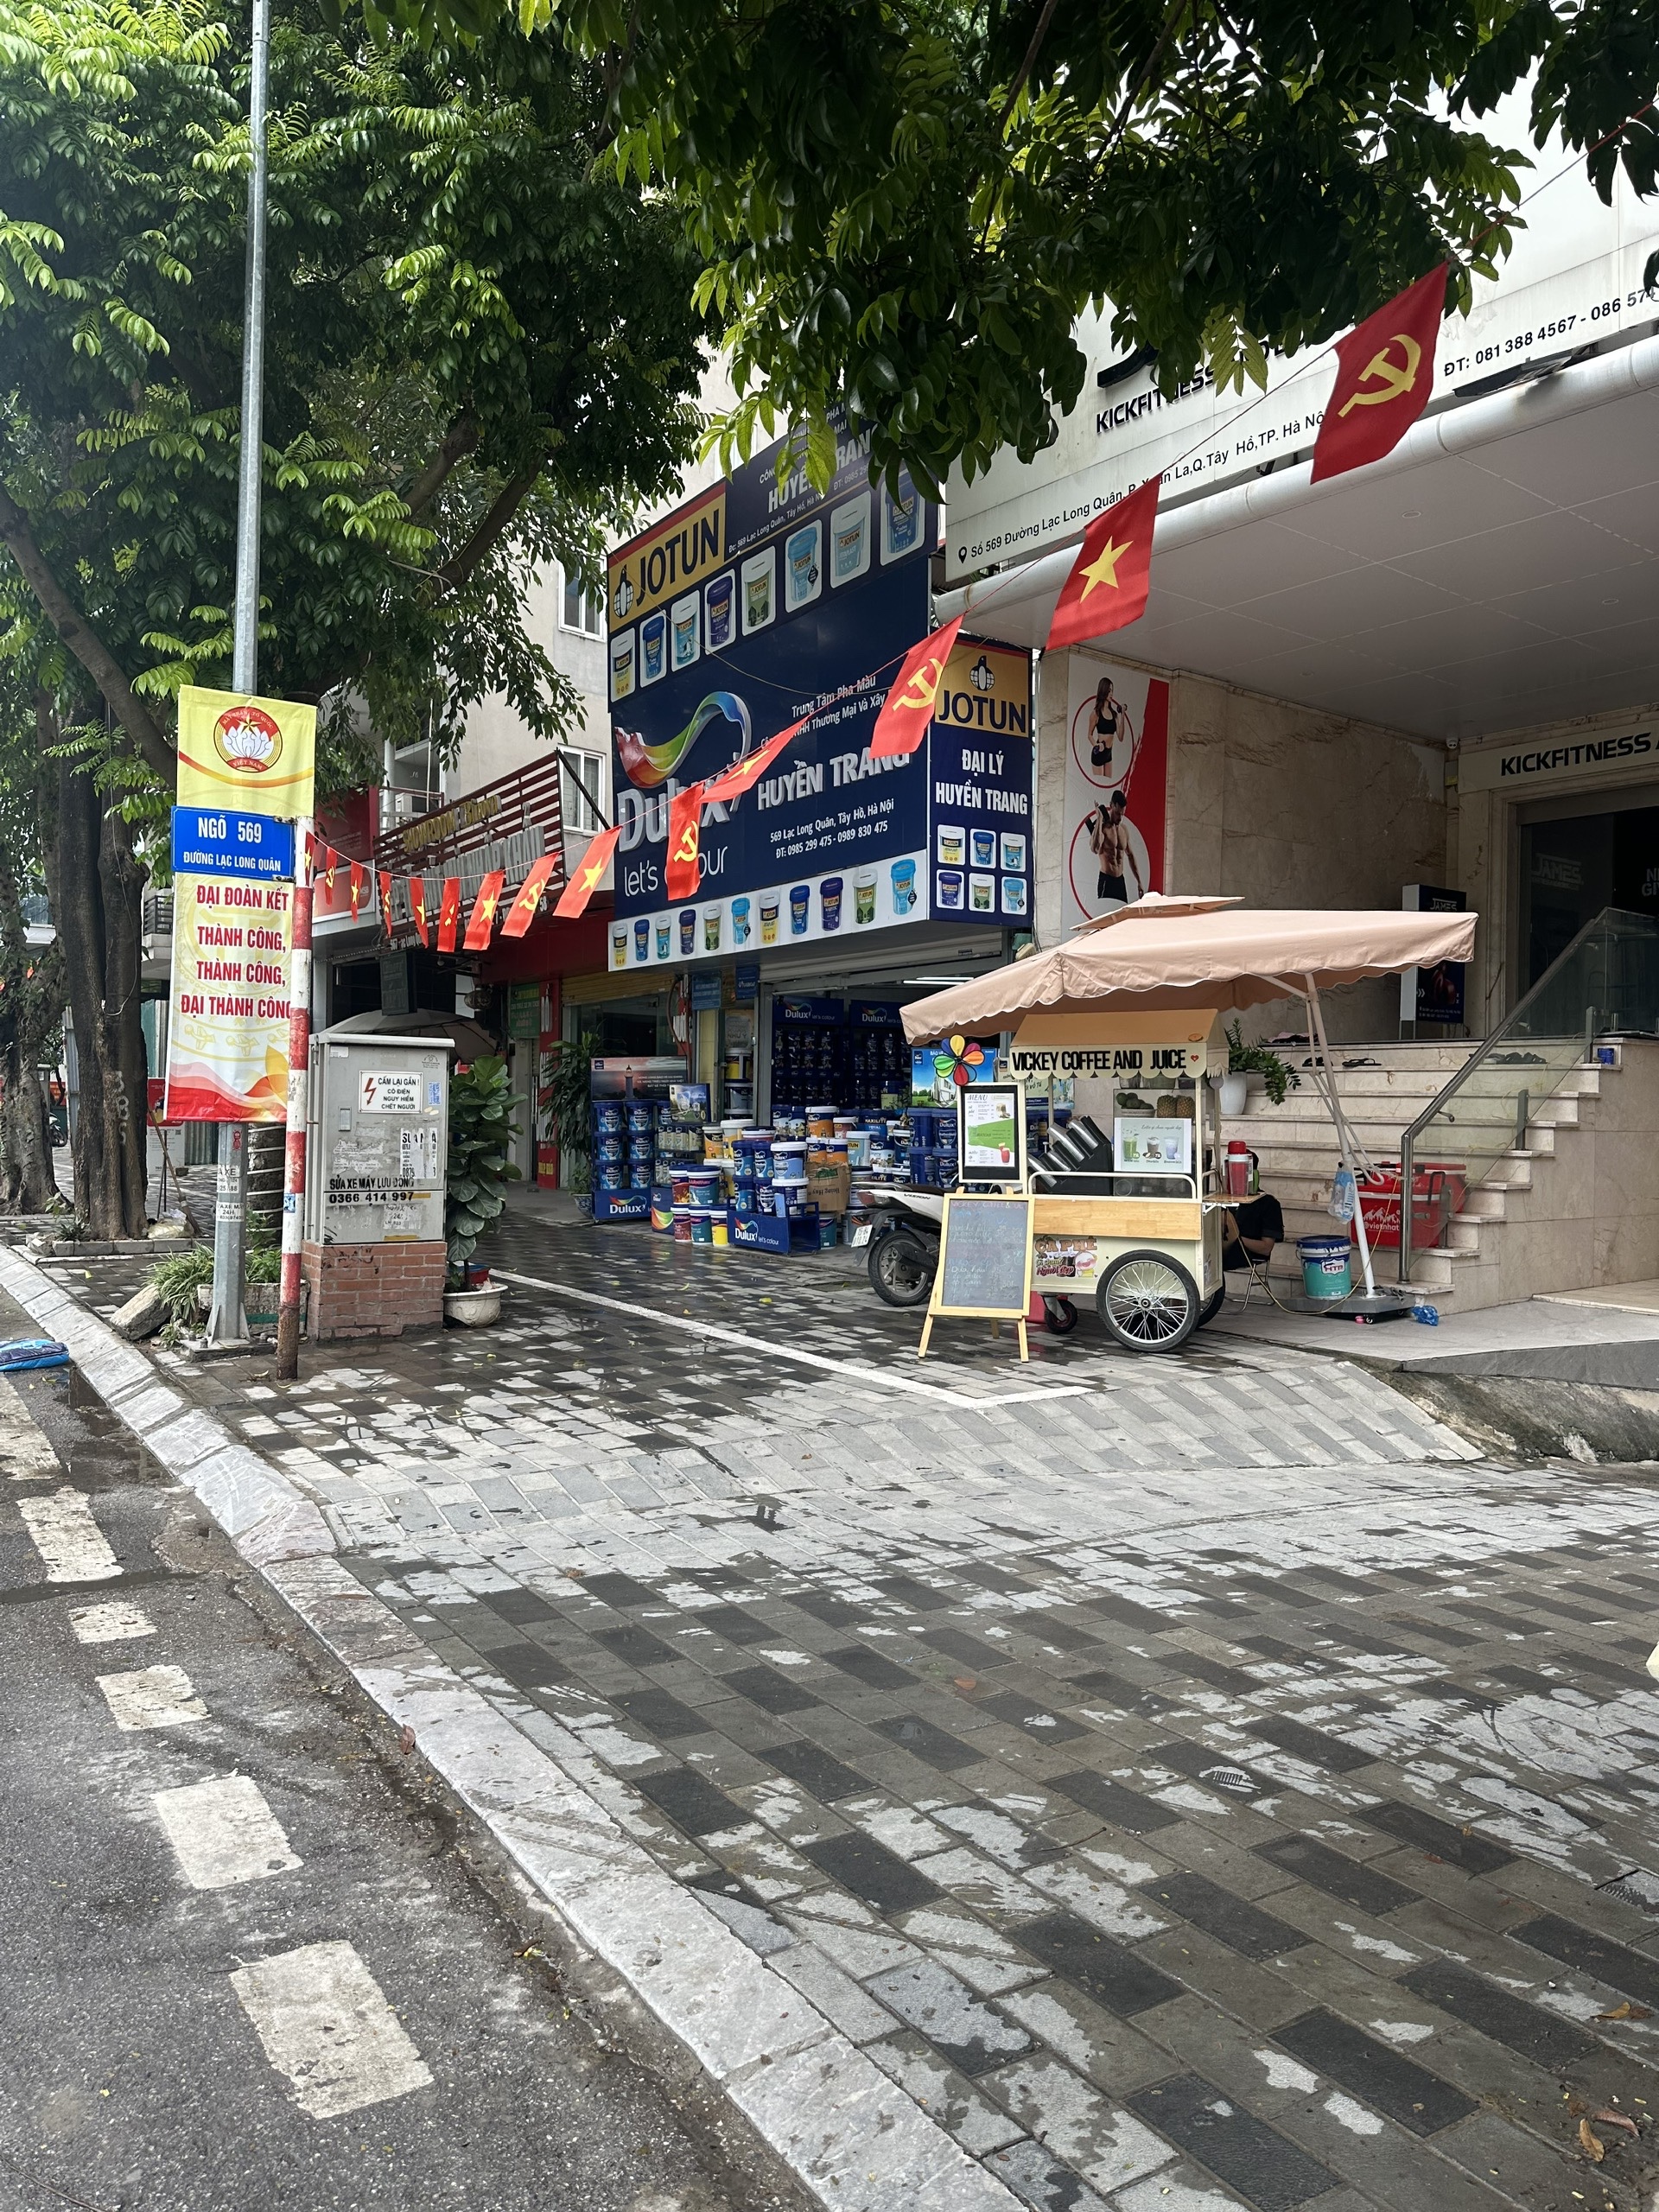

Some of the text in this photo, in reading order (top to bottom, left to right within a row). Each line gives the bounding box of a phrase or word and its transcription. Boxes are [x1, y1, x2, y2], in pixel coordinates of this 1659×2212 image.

[1444, 359, 1470, 377] ĐT:
[1476, 345, 1500, 365] 081
[1504, 331, 1533, 354] 388
[1537, 315, 1577, 340] 4567
[1591, 298, 1621, 321] 086
[1096, 365, 1215, 432] KICKFITESS
[834, 419, 847, 435] MẠI
[971, 541, 983, 557] Số
[986, 537, 1001, 550] 569
[1004, 524, 1039, 545] Đường
[1042, 515, 1060, 531] Lạc
[1064, 504, 1090, 522] Long
[1283, 420, 1300, 438] Hà
[1305, 411, 1325, 429] Nộ
[756, 524, 770, 541] Long
[786, 507, 797, 523] Tây
[844, 531, 860, 546] JOTUN
[636, 508, 719, 606] JOTUN
[797, 555, 811, 569] JOTUN
[791, 674, 876, 719] Trung Tâm Pha Màu
[811, 693, 885, 730] Thương Mại Và Xây
[938, 690, 1027, 734] JOTUN
[248, 760, 263, 771] NAM
[962, 748, 1004, 777] ĐẠI LÝ
[1501, 732, 1651, 777] KICKFITNESS
[757, 760, 824, 810] HUYỀN
[936, 779, 1028, 816] HUYỀN TRANG
[198, 815, 262, 843] NGÕ 569
[770, 830, 782, 843] 569
[783, 827, 795, 841] Lạc
[797, 820, 813, 837] Long
[815, 815, 836, 833] Quân,
[837, 810, 851, 823] Tây
[868, 803, 878, 817] Hà
[880, 798, 894, 813] Nội
[776, 819, 888, 859] ĐT: 0985 299 475 0989 830 475
[183, 849, 281, 872] ĐƯỜNG LẠC LONG QUÂN
[624, 860, 659, 897] let's
[197, 884, 289, 911] ĐẠI ĐOÀN KẾT
[197, 923, 286, 953] THÀNH CÔNG,
[196, 957, 285, 987] THÀNH CÔNG,
[181, 995, 204, 1018] ĐẠI
[208, 994, 253, 1018] THÀNH
[785, 1009, 808, 1019] Dulux
[862, 1014, 884, 1023] Dulux
[1012, 1049, 1186, 1071] VICKEY COFFEE AND JUICE
[378, 1076, 391, 1085] CẤM
[392, 1078, 403, 1087] LẠI
[330, 1174, 346, 1190] SỬA
[347, 1179, 357, 1189] XE
[329, 1192, 414, 1204] 0366 414 997
[609, 1204, 643, 1214] Dulux
[735, 1227, 757, 1242] Dulux
